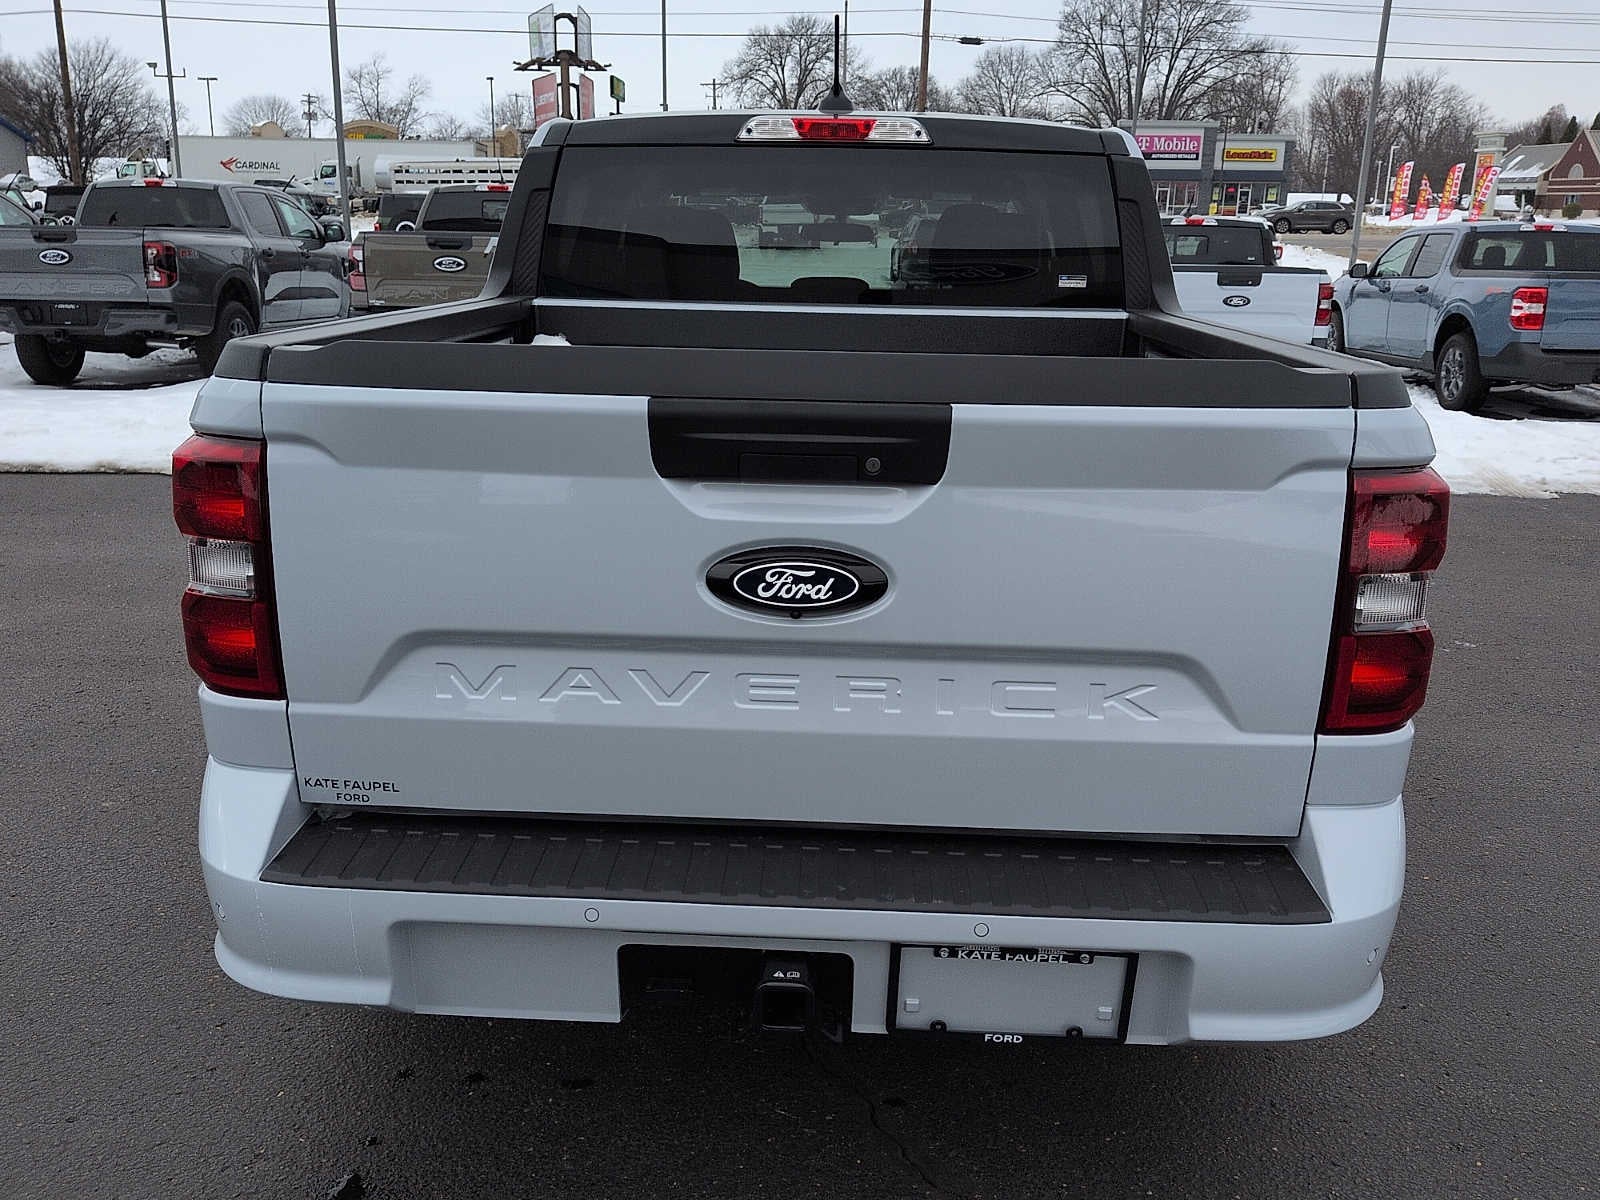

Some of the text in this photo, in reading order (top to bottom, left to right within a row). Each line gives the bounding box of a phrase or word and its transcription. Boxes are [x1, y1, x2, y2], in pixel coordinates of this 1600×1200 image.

[1153, 136, 1199, 151] Mobile
[235, 160, 280, 170] CARDINAL
[757, 568, 835, 600] Ford
[435, 662, 1160, 721] MAVERICK
[304, 777, 400, 793] KATE FAUPEL
[336, 792, 370, 803] FORD
[957, 950, 1069, 964] KATE FAUPEL
[984, 1033, 1024, 1044] FORD
